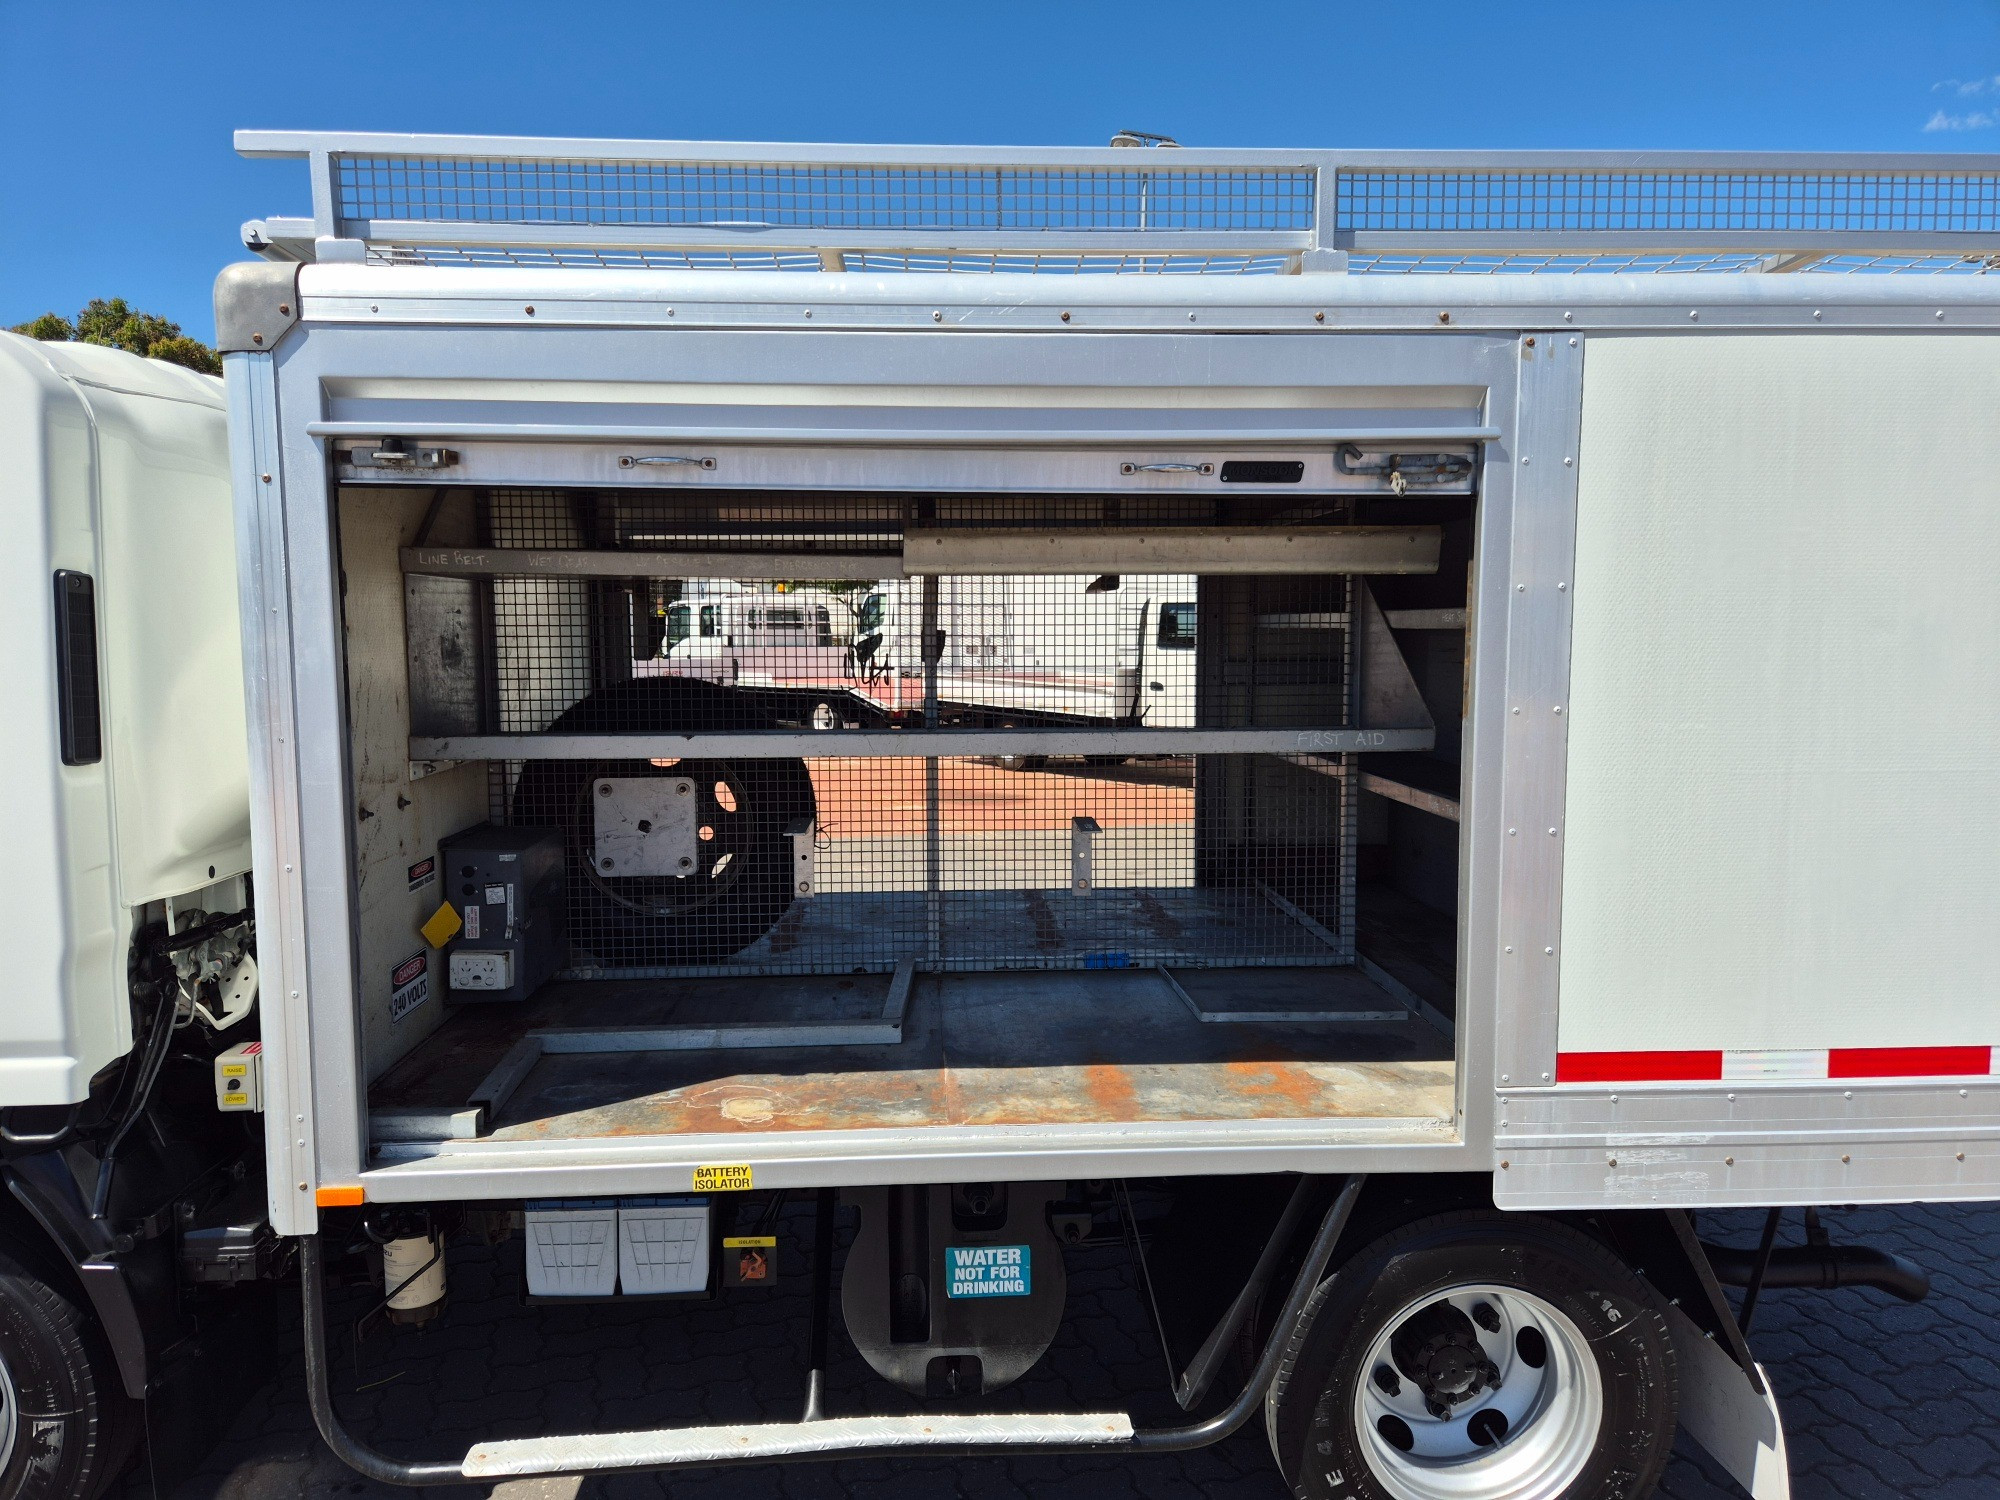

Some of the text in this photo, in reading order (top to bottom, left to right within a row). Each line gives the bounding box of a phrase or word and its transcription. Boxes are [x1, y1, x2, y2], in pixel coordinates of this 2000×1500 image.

[419, 552, 449, 566] LINE
[1297, 731, 1385, 747] FIRST AID
[399, 960, 422, 982] DANGER
[393, 978, 427, 1017] 240 VOLTS
[696, 1166, 748, 1178] BATTERY
[695, 1177, 750, 1190] ISOLATOR
[954, 1248, 1021, 1266] WATER
[954, 1265, 1021, 1281] NOT FOR
[952, 1279, 1025, 1295] DRINKING
